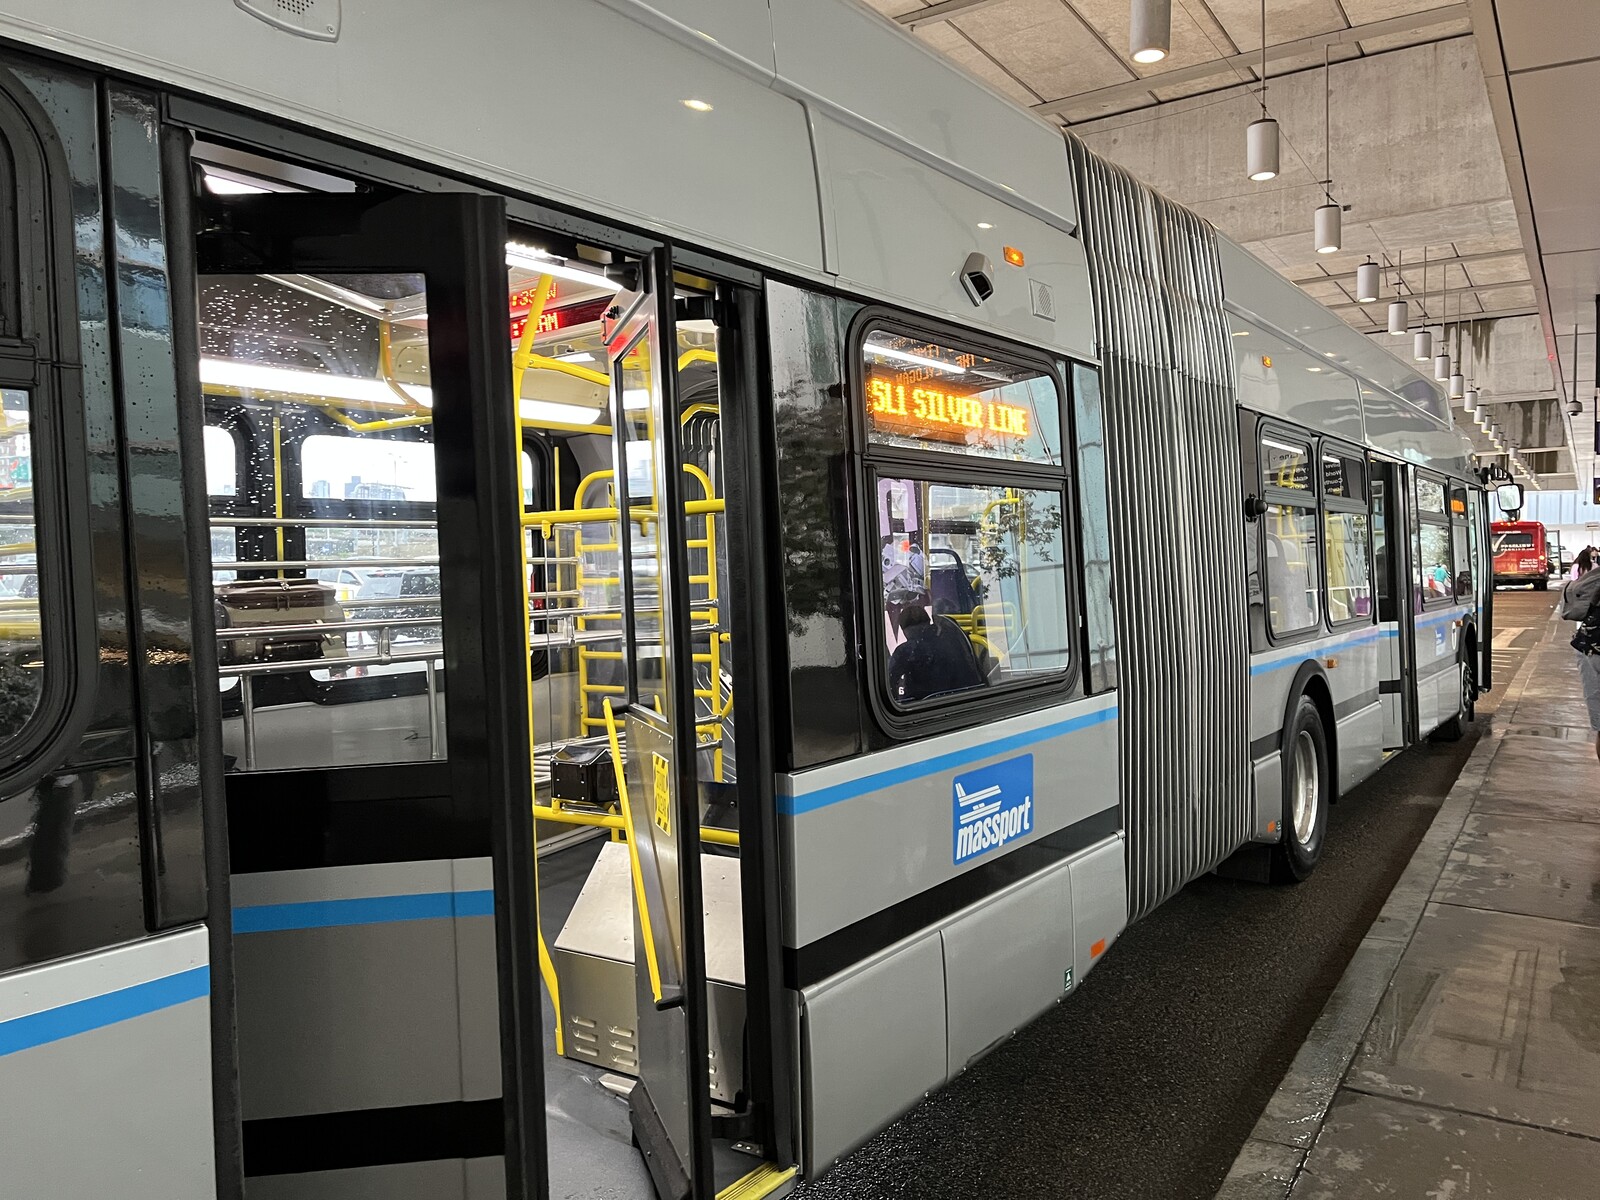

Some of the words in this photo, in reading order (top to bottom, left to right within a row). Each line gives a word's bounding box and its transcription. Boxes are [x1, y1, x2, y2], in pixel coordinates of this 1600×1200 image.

[870, 378, 908, 416] SL1
[912, 388, 984, 429] SILVER
[988, 402, 1029, 436] LINE
[956, 795, 1031, 861] massport
